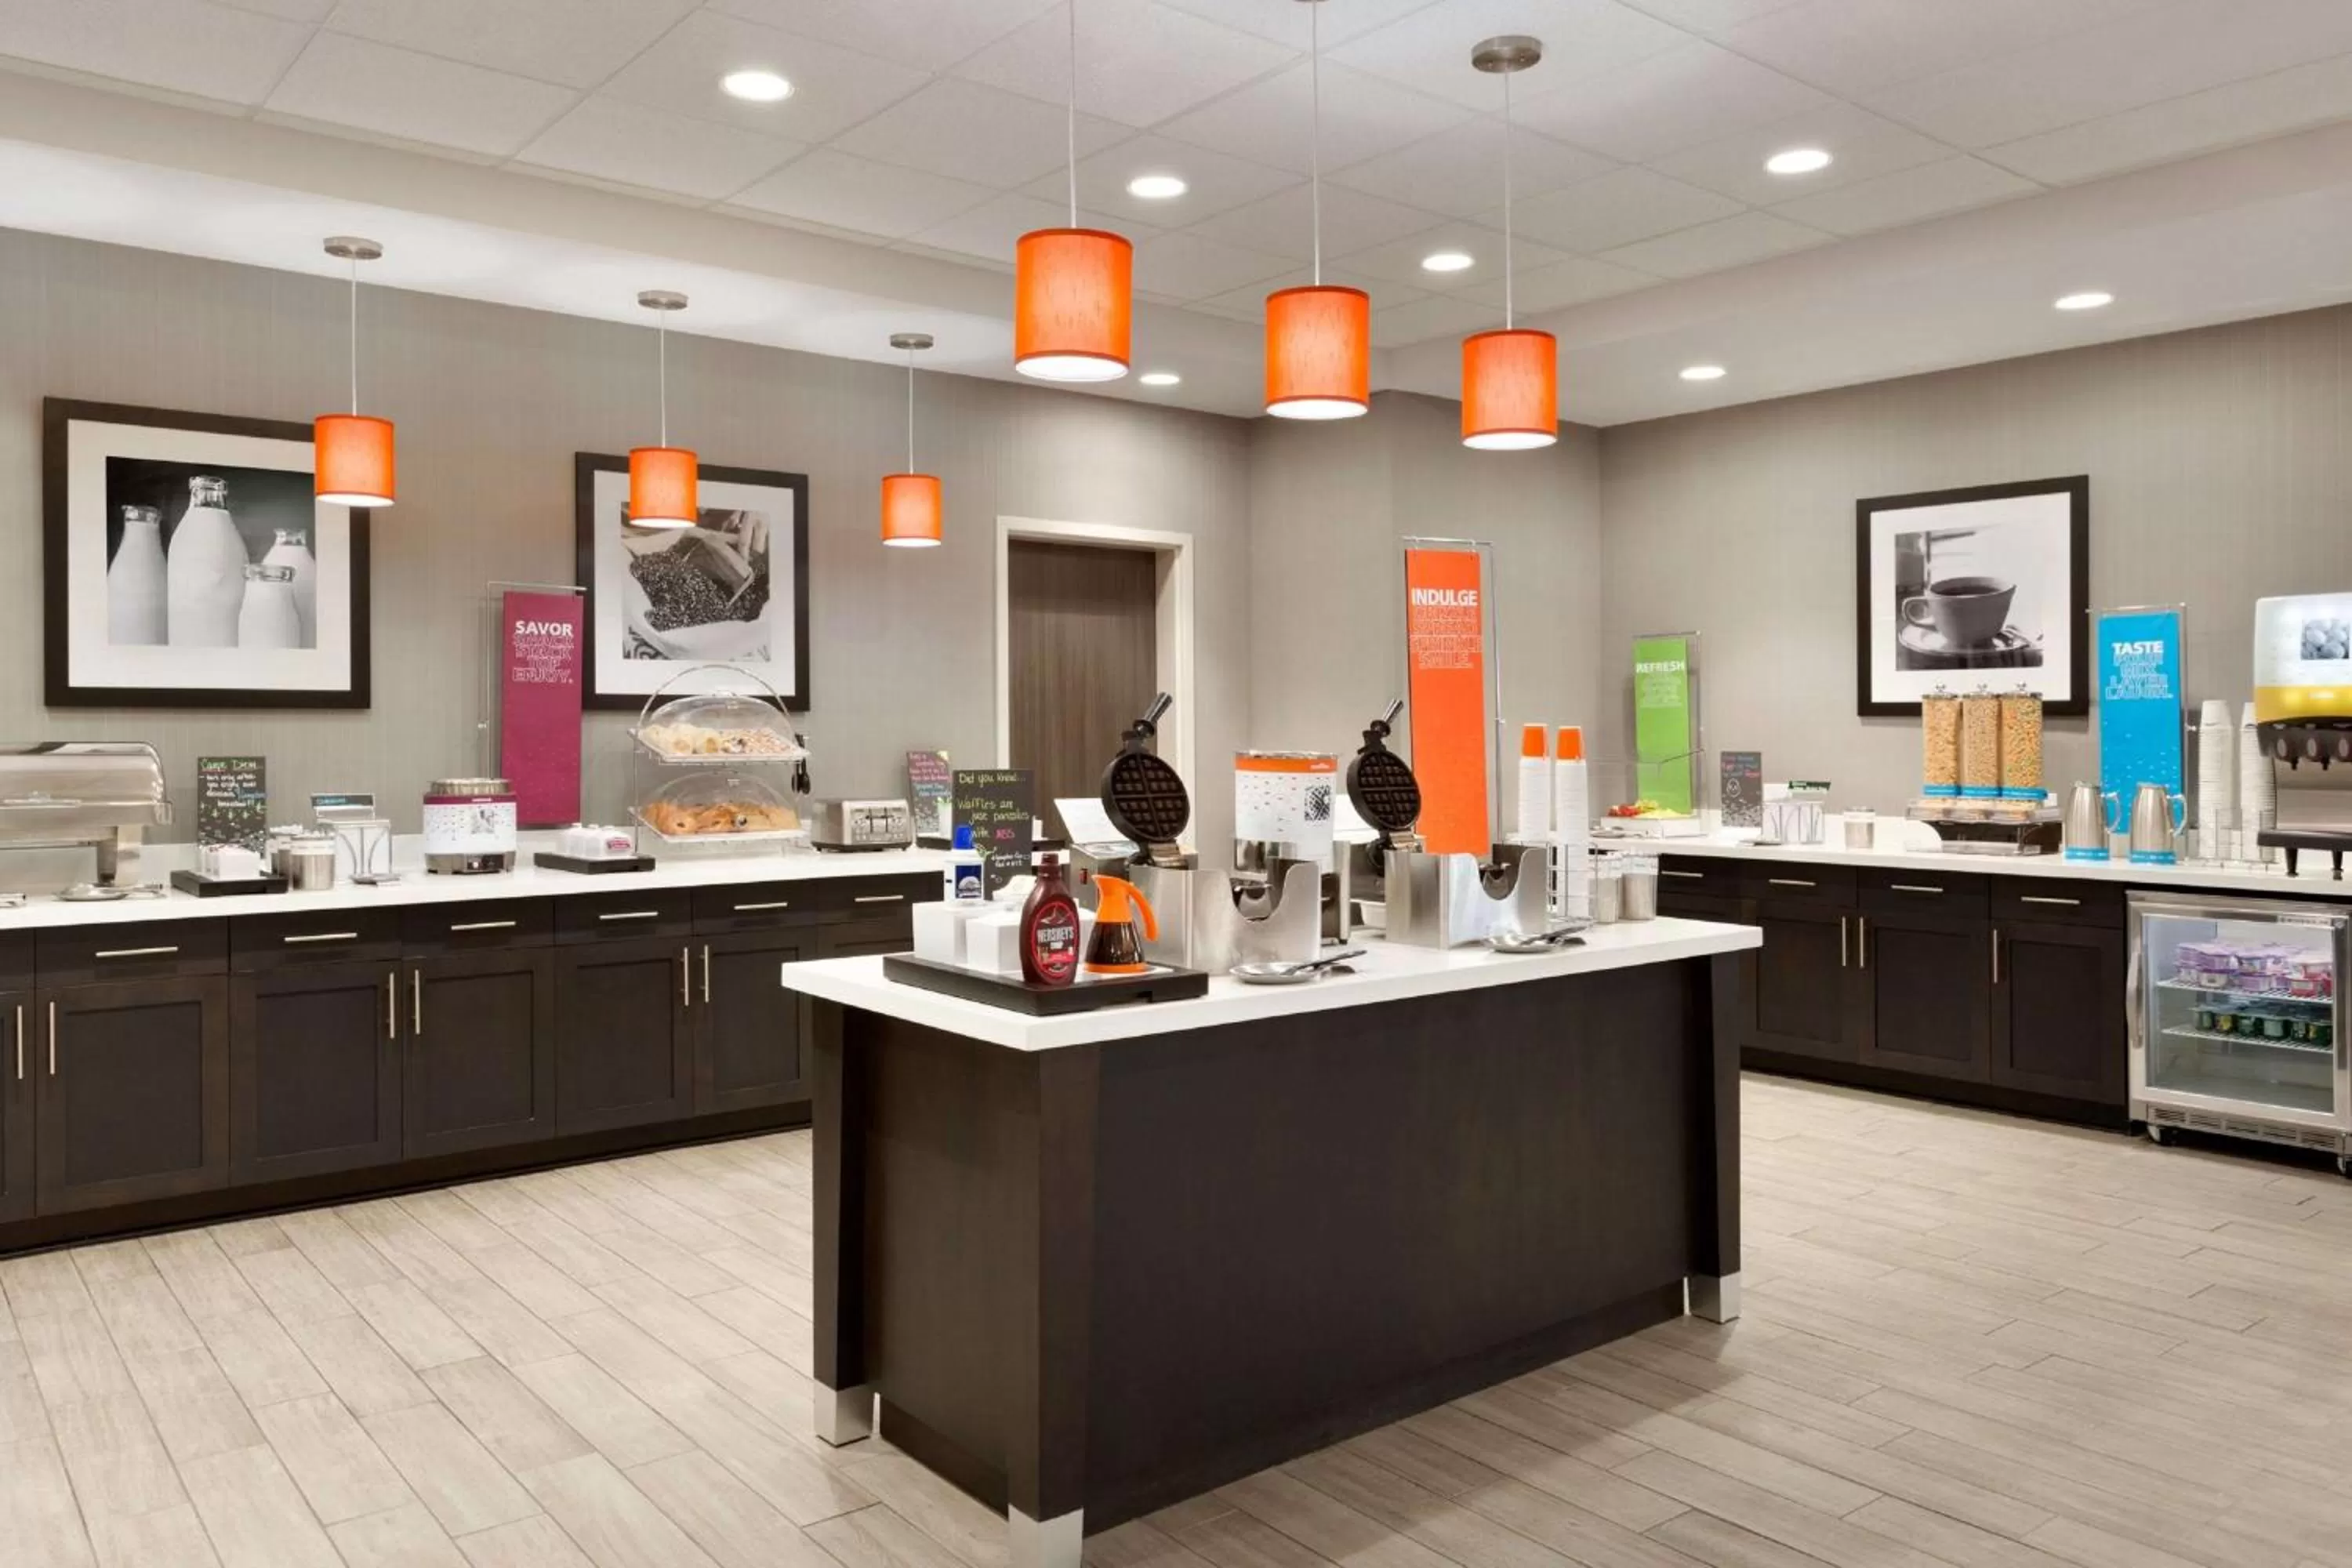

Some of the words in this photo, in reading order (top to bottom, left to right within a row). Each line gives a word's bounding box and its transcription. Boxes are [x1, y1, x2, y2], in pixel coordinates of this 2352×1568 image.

[1411, 588, 1478, 606] INDULGE
[514, 620, 574, 636] SAVOR
[2111, 641, 2164, 655] TASTE
[1635, 660, 1685, 674] REFRESH
[959, 772, 975, 784] Did
[978, 773, 995, 788] you
[957, 794, 996, 809] Waffles
[993, 808, 1030, 822] pancakes
[1037, 926, 1074, 943] HERSHEY'S
